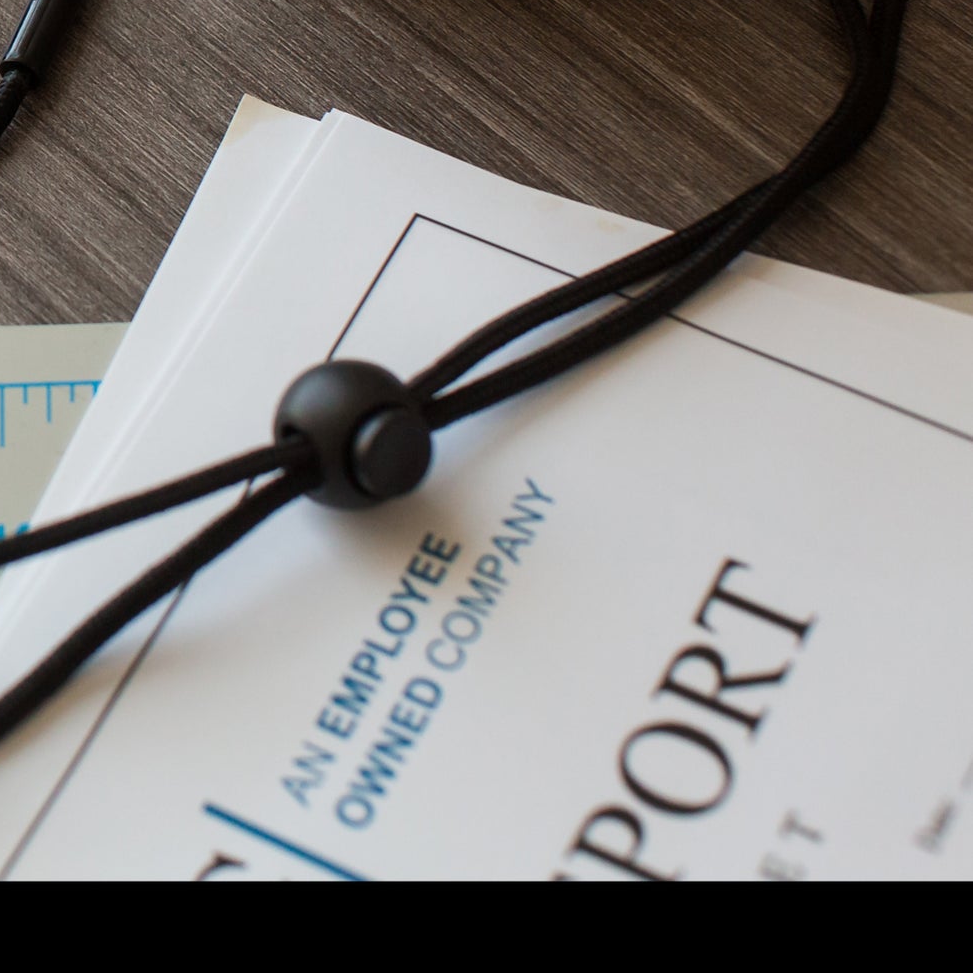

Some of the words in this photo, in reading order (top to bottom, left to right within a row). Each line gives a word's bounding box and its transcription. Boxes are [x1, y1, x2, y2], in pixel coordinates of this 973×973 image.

[281, 740, 336, 808] AN
[316, 531, 462, 740] EMPLOYEE
[334, 676, 444, 830] OWNED
[425, 476, 556, 673] COMPANY
[550, 554, 818, 880] PORT
